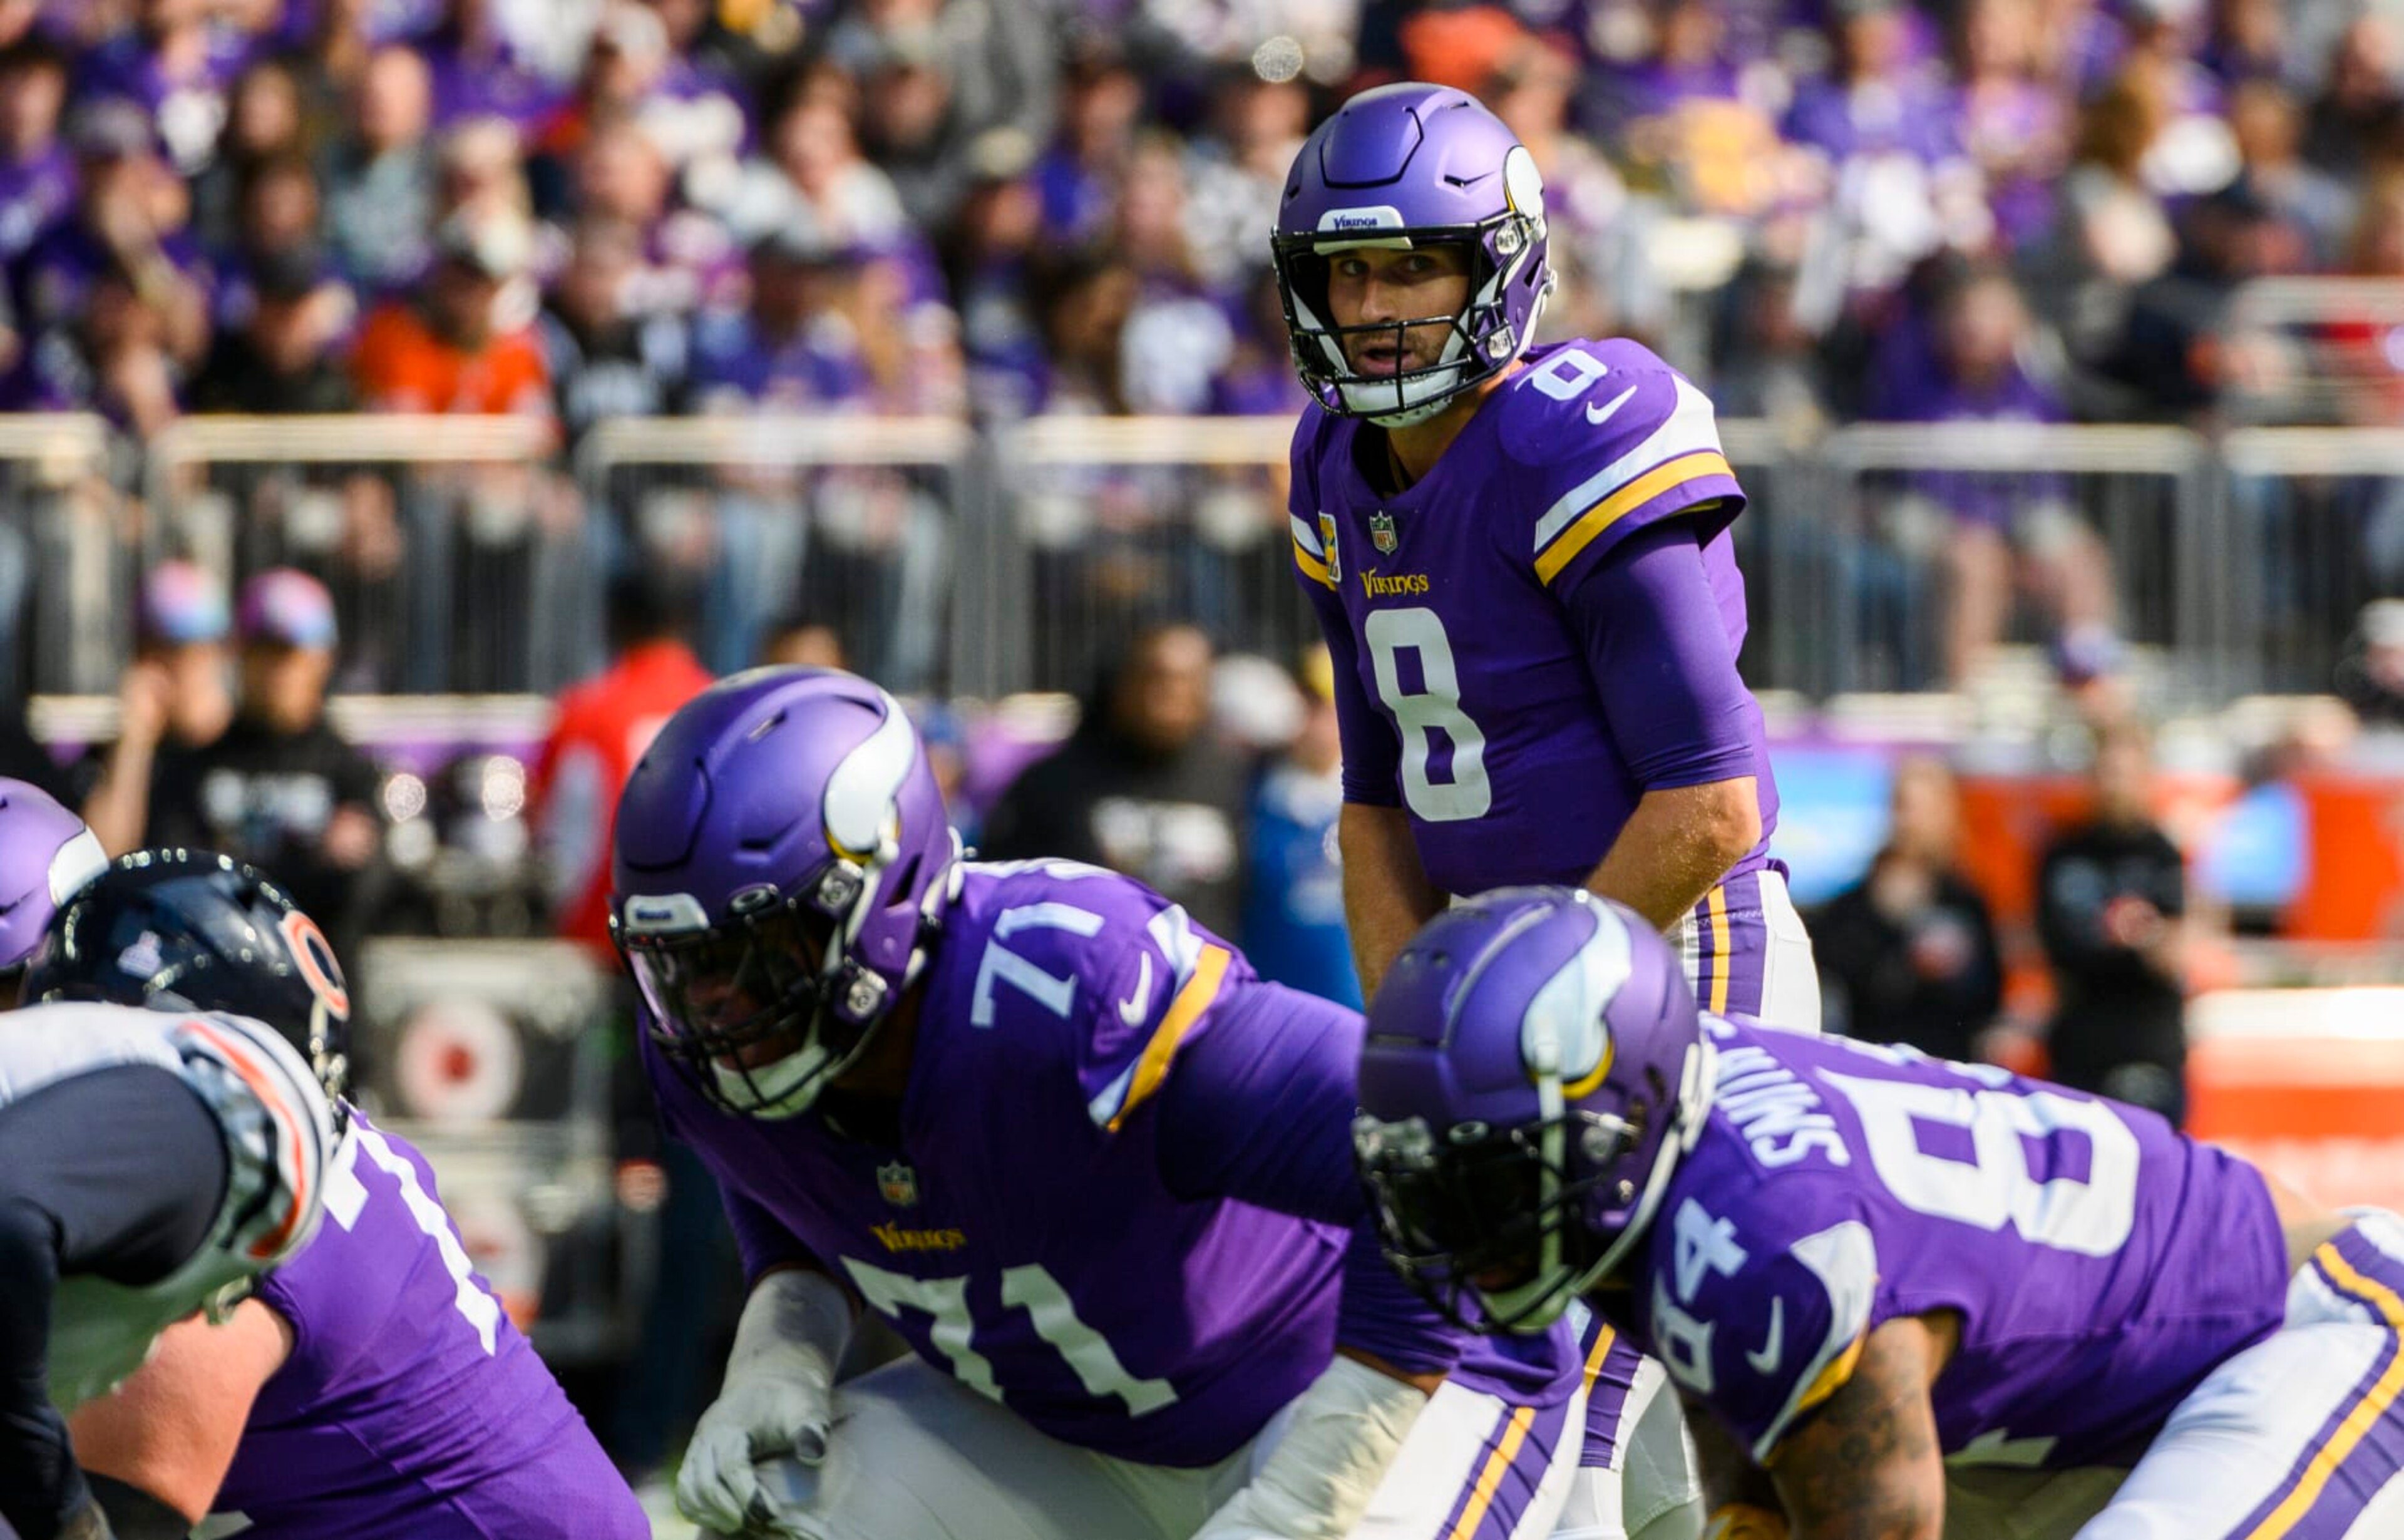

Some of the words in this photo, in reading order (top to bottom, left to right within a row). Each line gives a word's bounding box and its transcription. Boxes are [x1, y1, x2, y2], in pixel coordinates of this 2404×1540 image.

[1365, 607, 1492, 822] 8
[970, 901, 1105, 1028] 71
[839, 1255, 1179, 1417] 71
